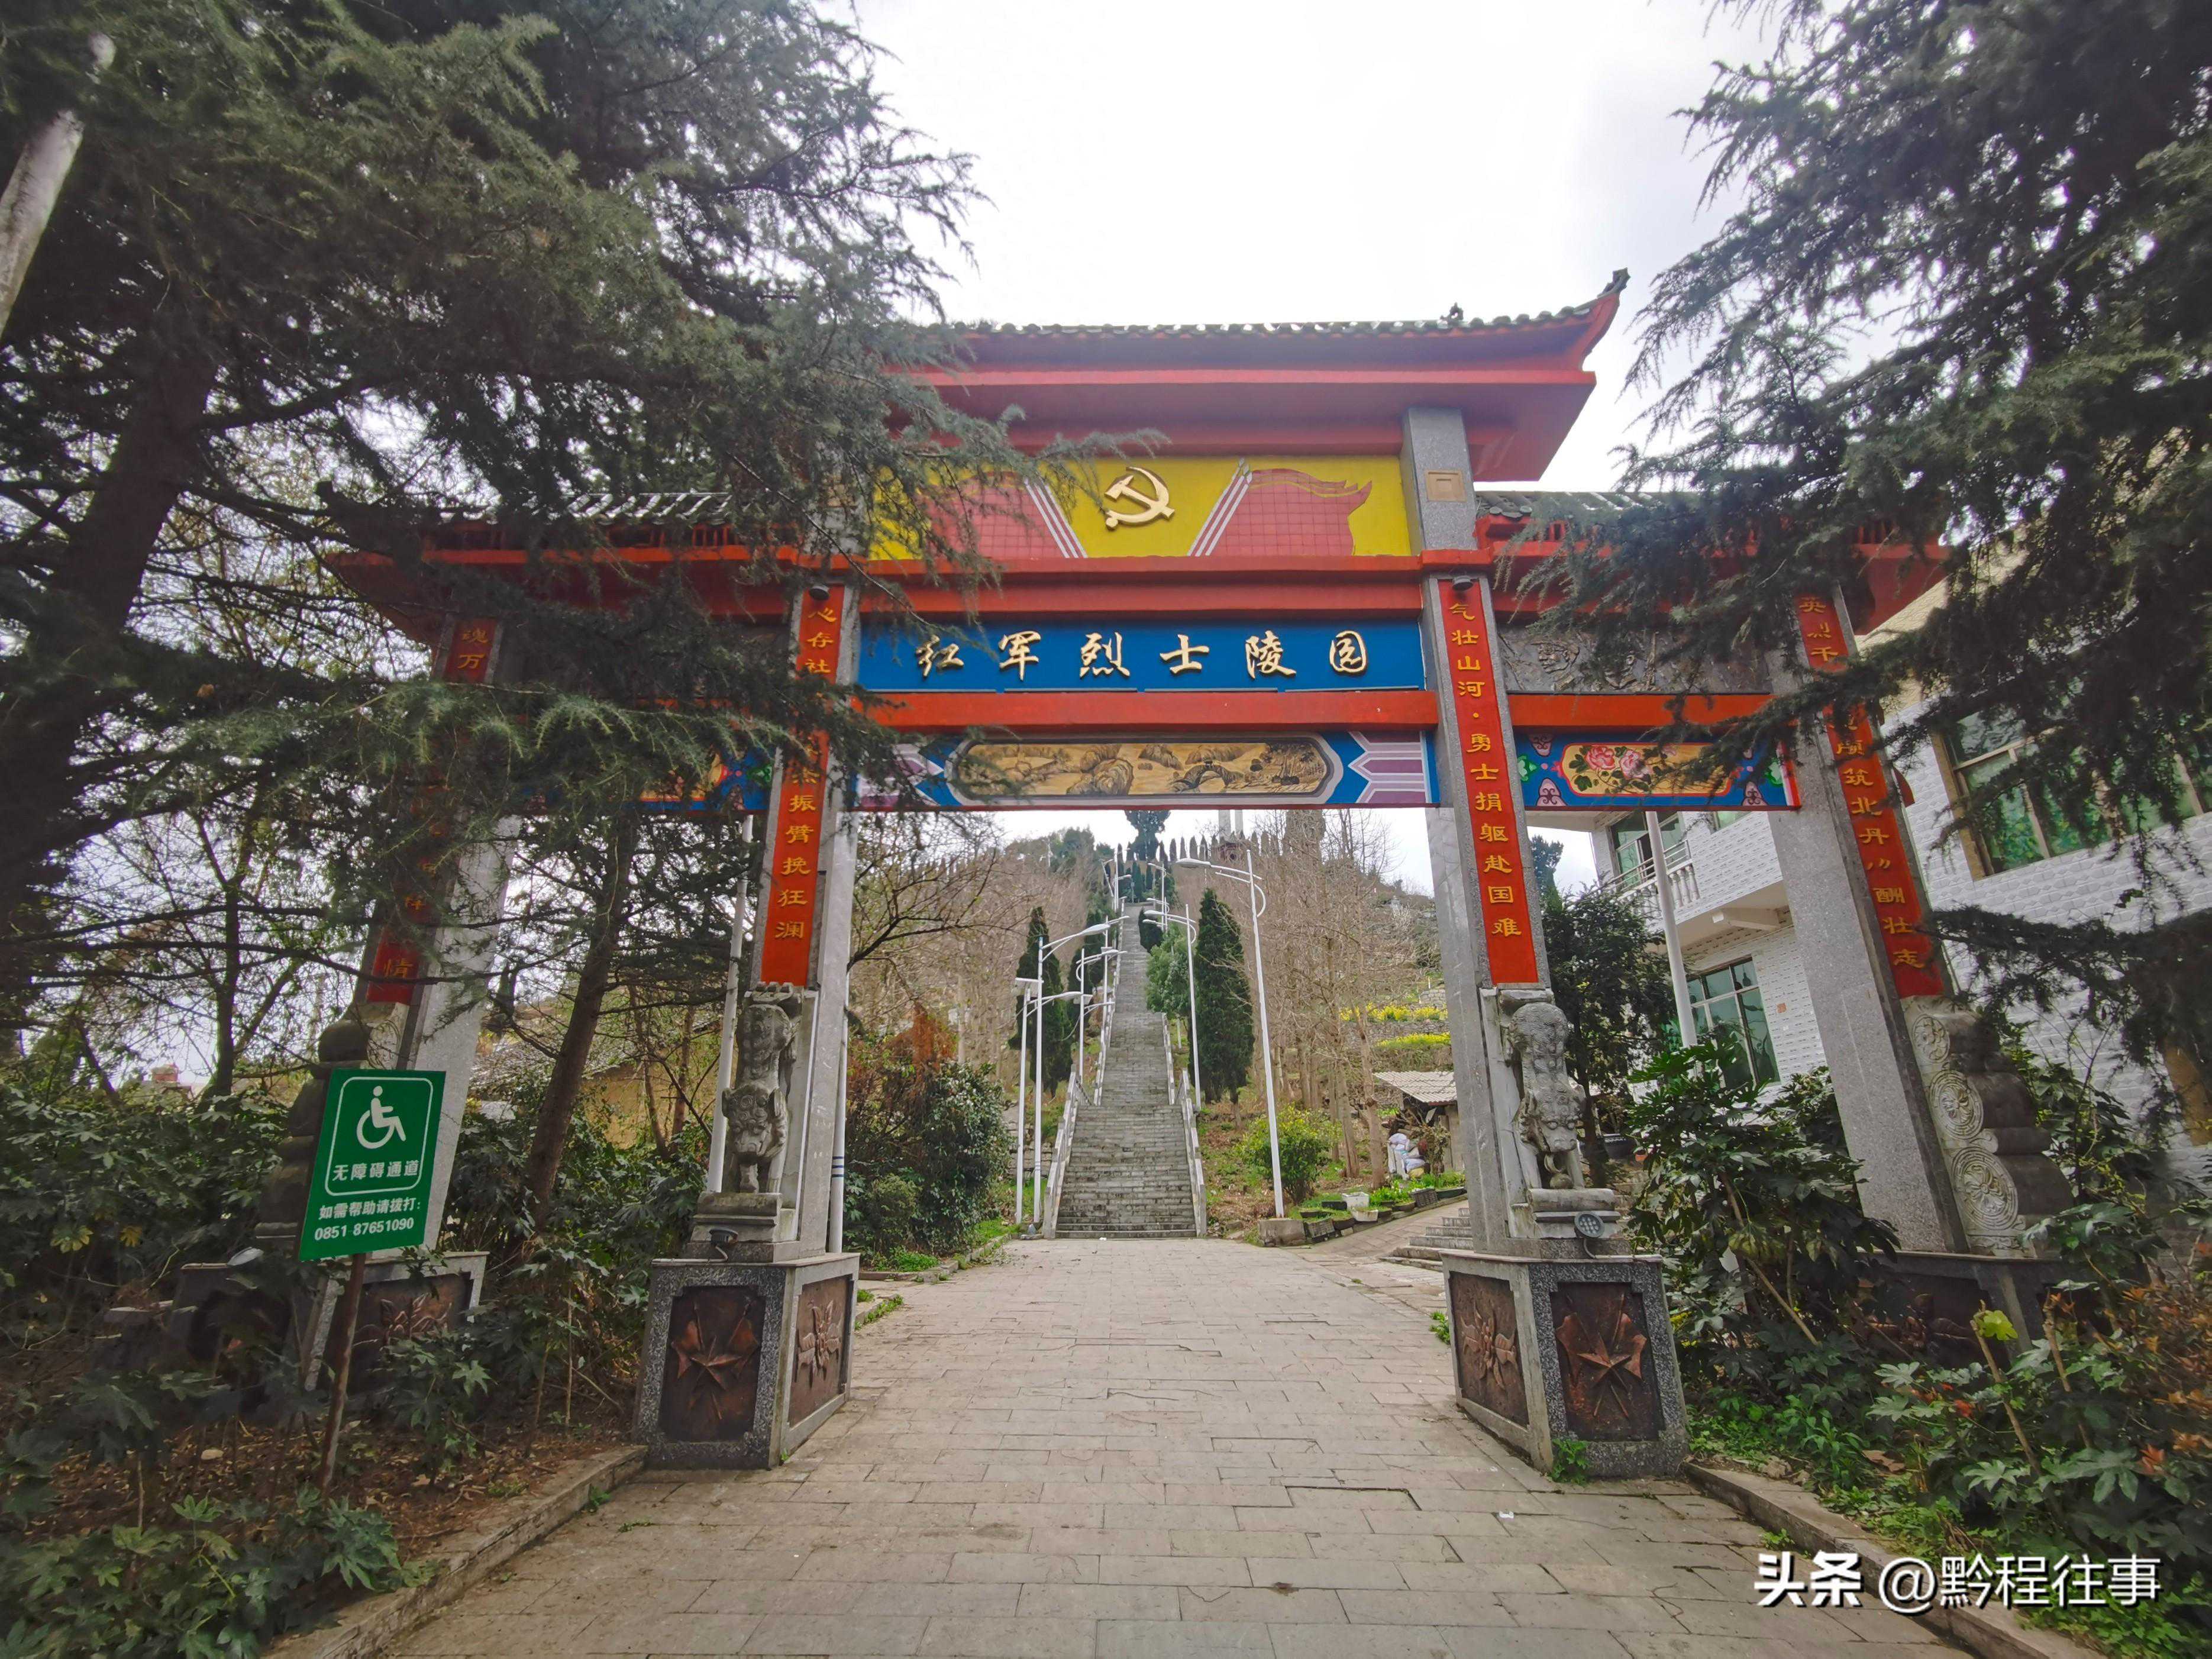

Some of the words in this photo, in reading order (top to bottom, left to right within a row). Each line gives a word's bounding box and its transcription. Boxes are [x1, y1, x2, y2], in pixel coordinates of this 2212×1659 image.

[916, 630, 1368, 680] 红军烈士陵园
[1449, 602, 1522, 938] 气壮山河·勇士捐躯赴国难
[332, 1160, 419, 1181] 无障碍通道
